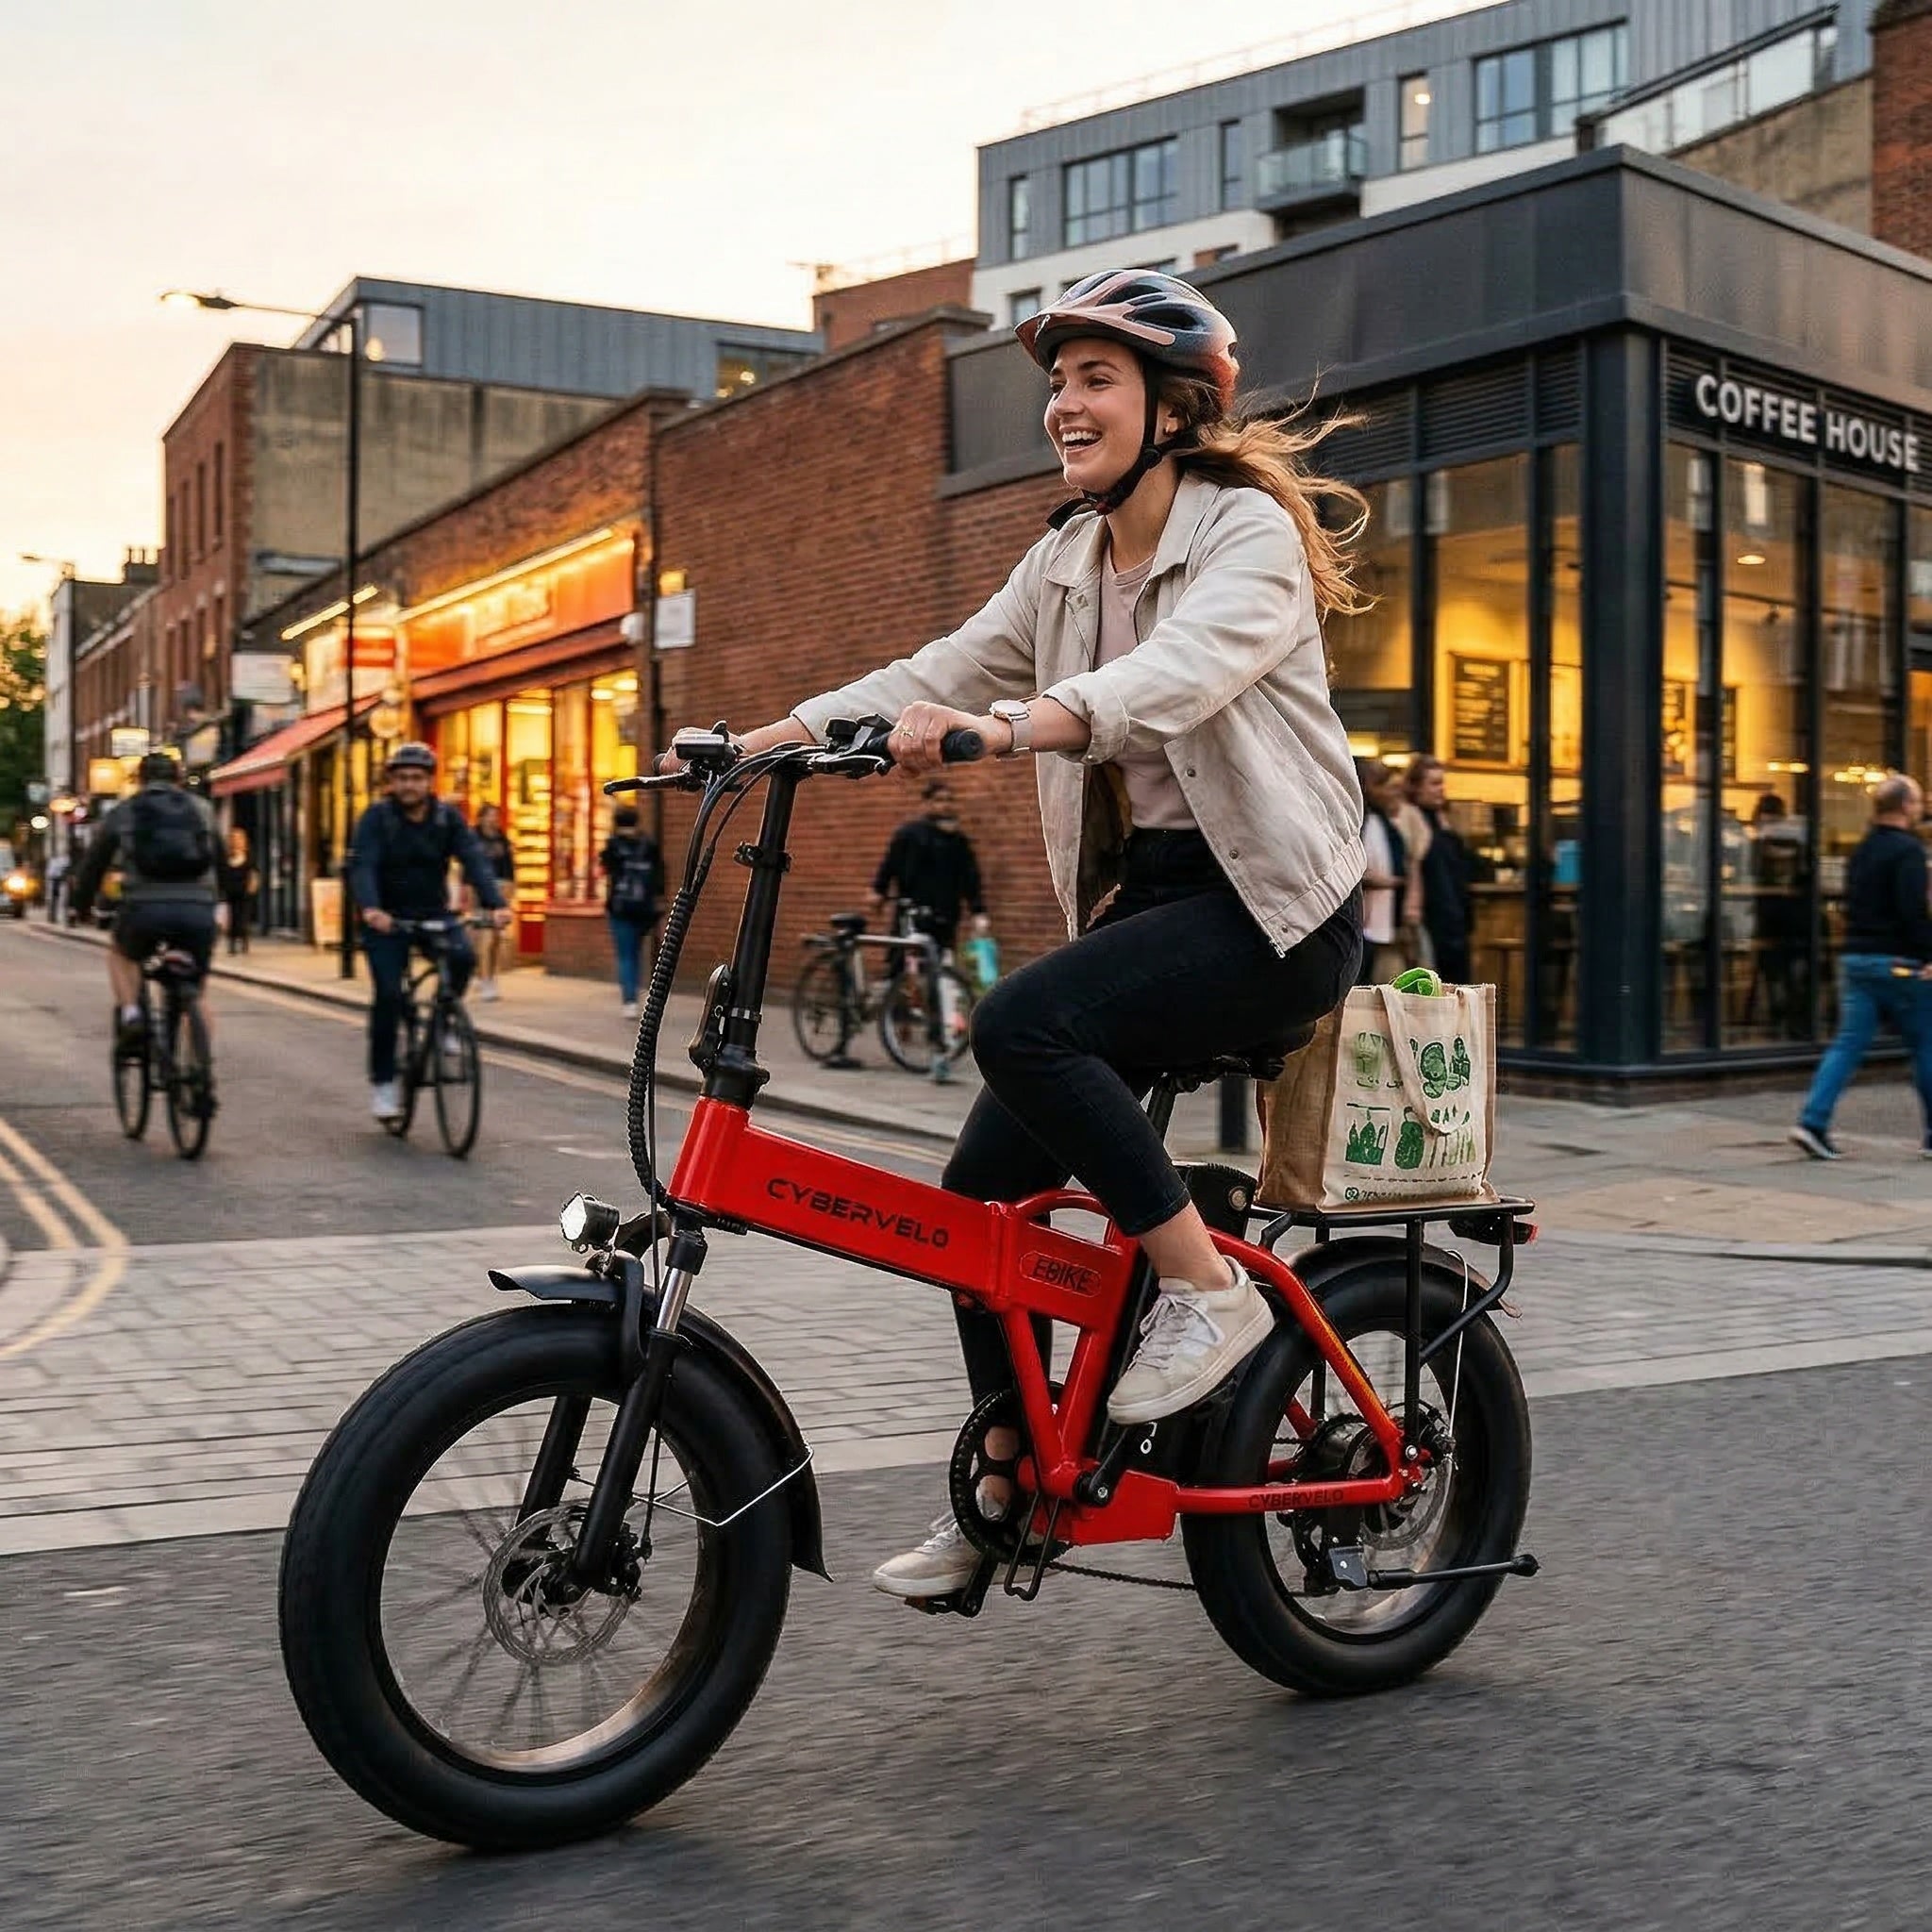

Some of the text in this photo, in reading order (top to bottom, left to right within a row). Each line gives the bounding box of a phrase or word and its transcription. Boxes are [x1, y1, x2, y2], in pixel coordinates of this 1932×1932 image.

[1696, 374, 1920, 472] COFFEE HOUSE
[767, 1178, 949, 1249] CYBERVELO
[1032, 1257, 1092, 1292] EBIKE
[1248, 1490, 1344, 1508] CYBERVELO
